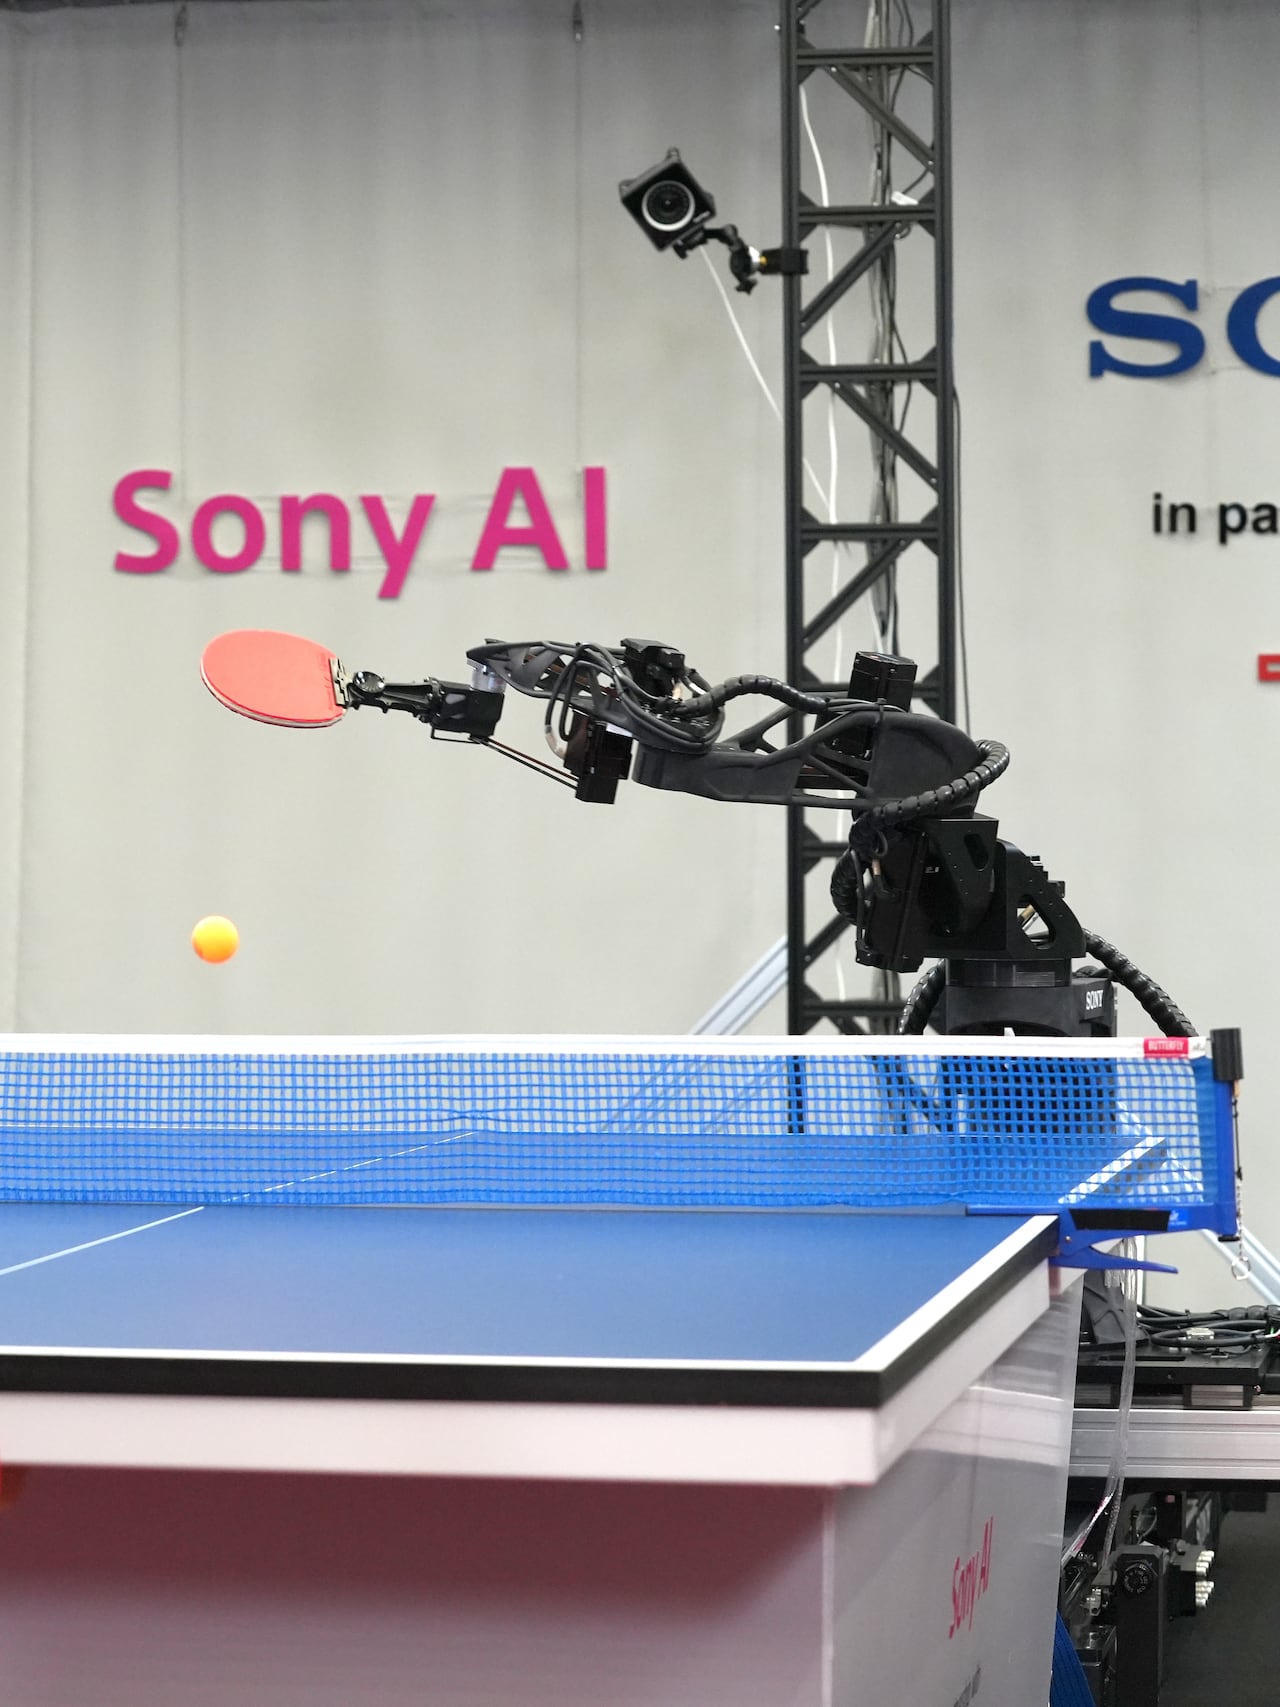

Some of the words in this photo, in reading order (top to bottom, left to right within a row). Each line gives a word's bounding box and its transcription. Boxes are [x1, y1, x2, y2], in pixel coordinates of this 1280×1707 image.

[113, 469, 435, 599] Sony
[472, 466, 608, 571] AI
[1153, 492, 1197, 534] in
[1085, 989, 1104, 1011] SONY
